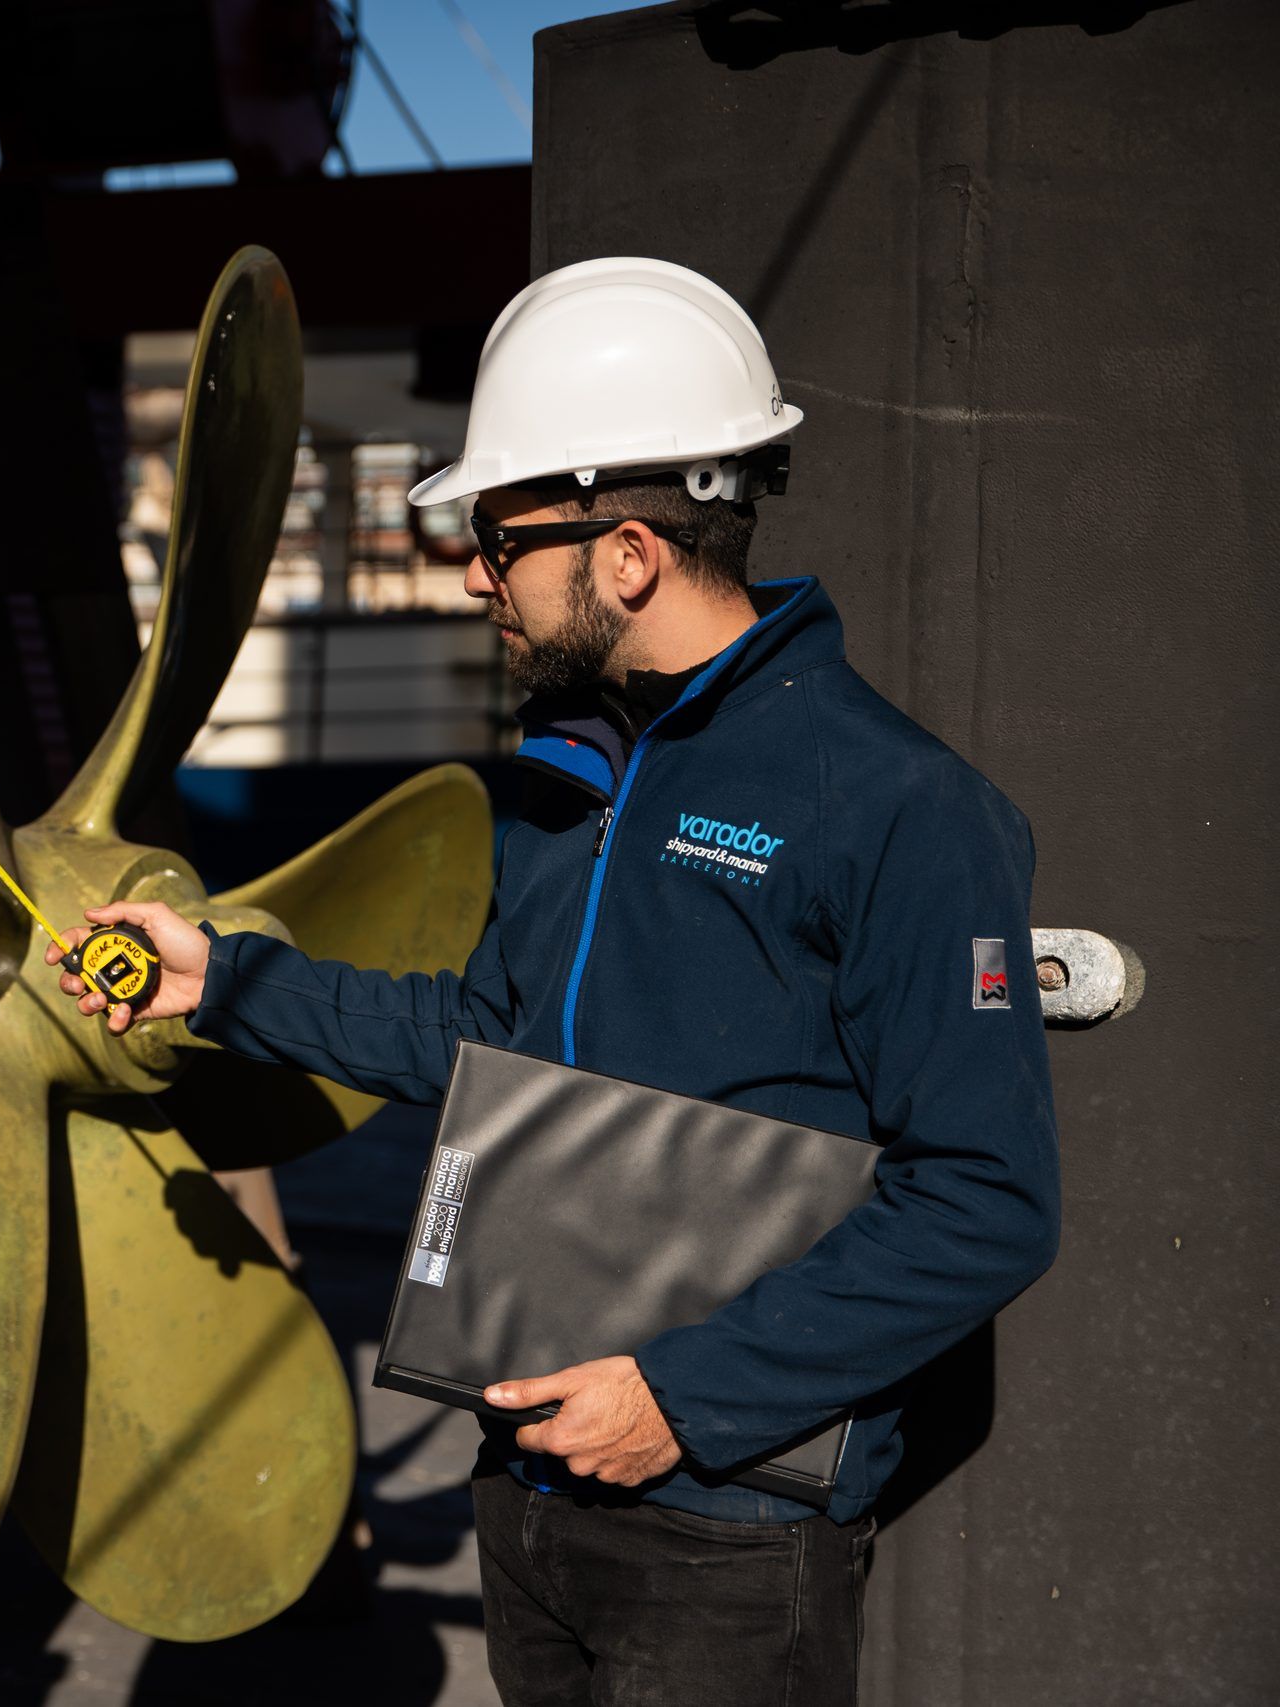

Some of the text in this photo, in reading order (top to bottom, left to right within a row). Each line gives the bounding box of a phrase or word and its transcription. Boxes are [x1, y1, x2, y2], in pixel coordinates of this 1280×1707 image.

[679, 813, 784, 858] varador
[659, 853, 760, 887] BARCELONA
[88, 936, 142, 967] OSCAR RUBIO
[443, 1153, 463, 1198] marina
[453, 1155, 470, 1201] barcelona
[420, 1201, 439, 1248] varador
[433, 1205, 449, 1237] 2000
[438, 1206, 458, 1253] shipyard
[427, 1255, 446, 1283] 1984
